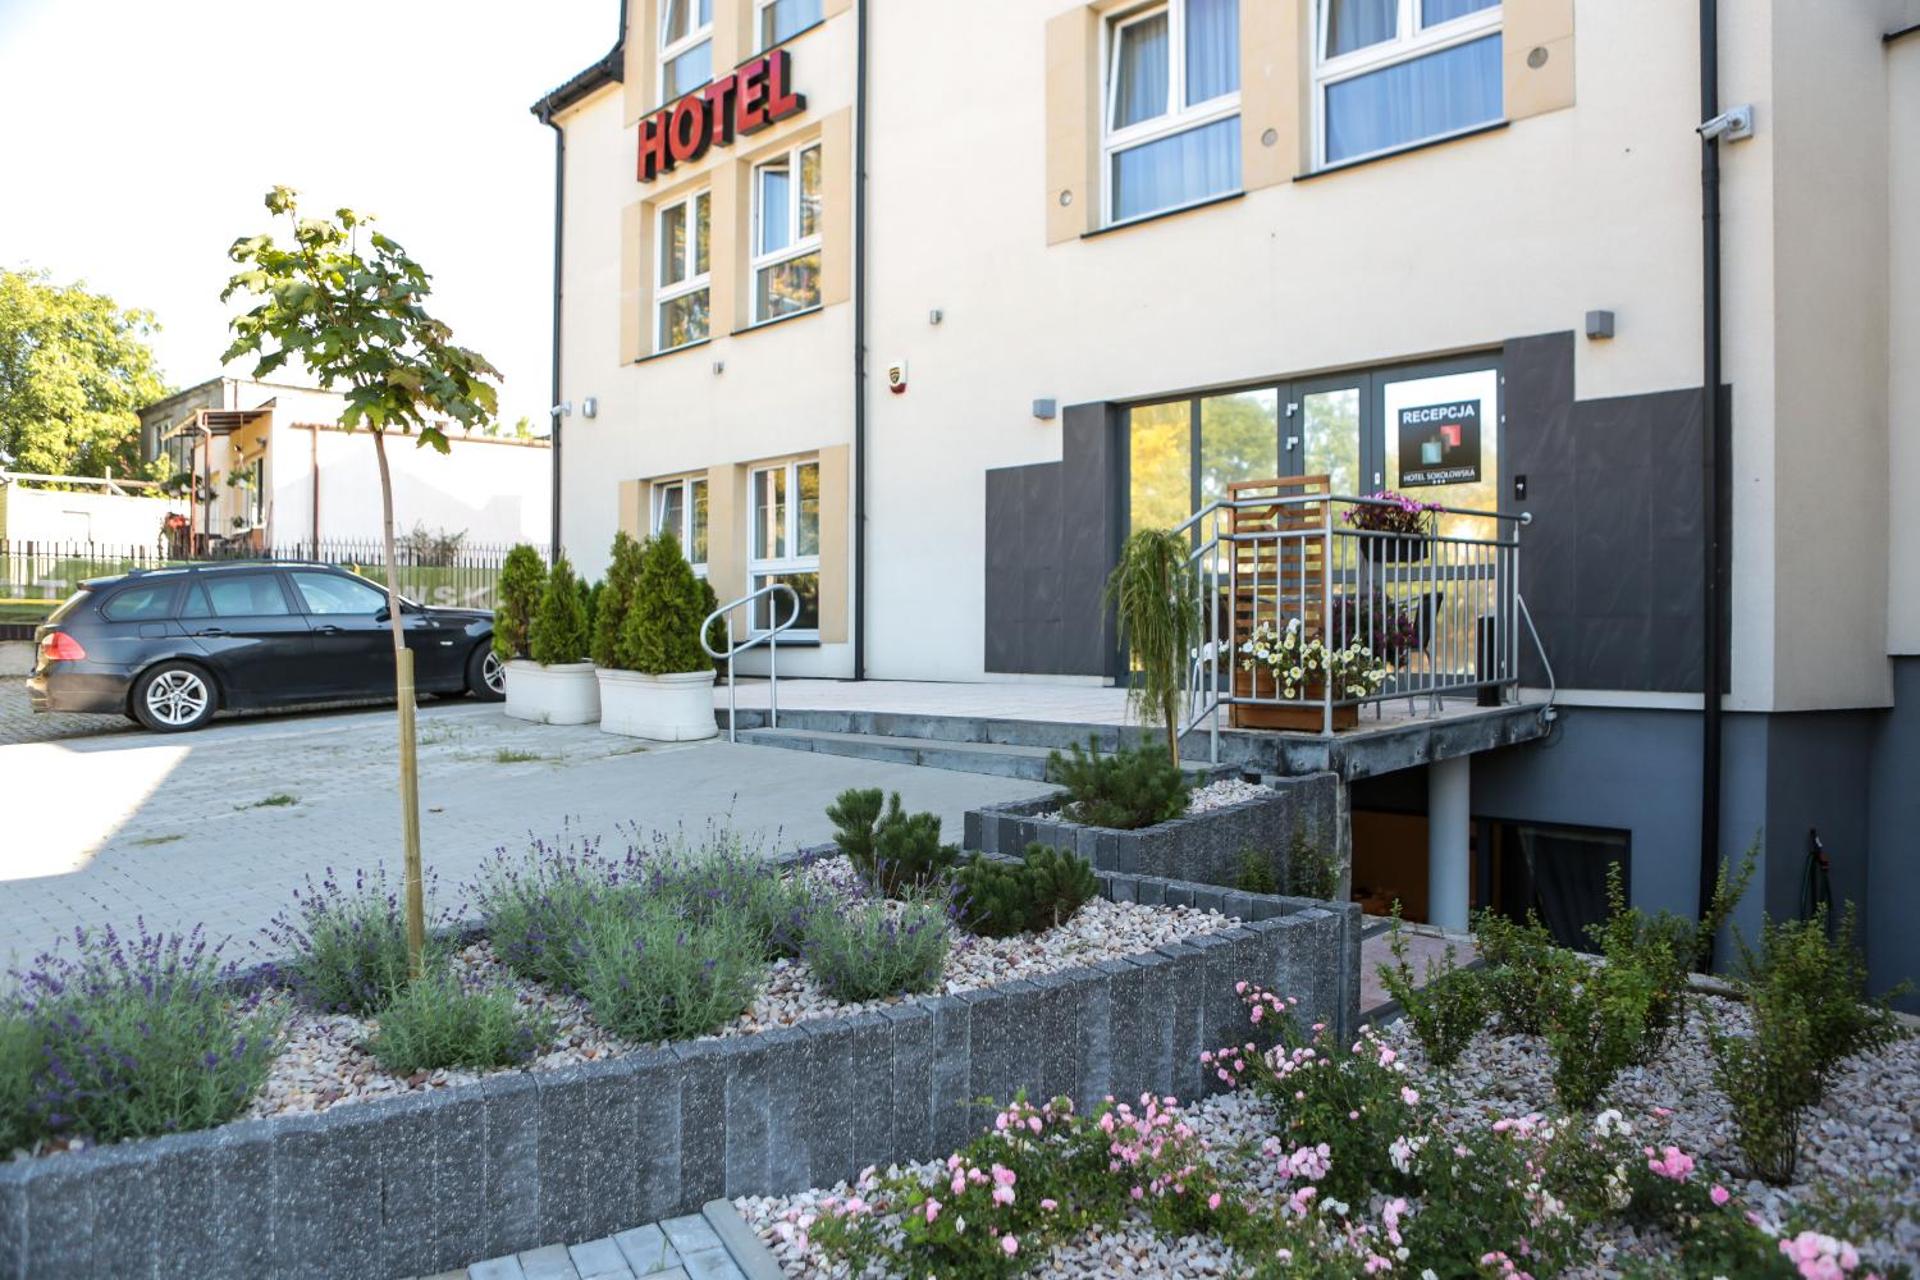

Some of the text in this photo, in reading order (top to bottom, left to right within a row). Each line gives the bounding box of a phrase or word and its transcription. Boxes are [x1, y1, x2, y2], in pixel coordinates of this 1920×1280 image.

[636, 49, 807, 183] HOTEL
[1403, 404, 1475, 424] RECEPCJA
[1403, 472, 1425, 482] HOTEL
